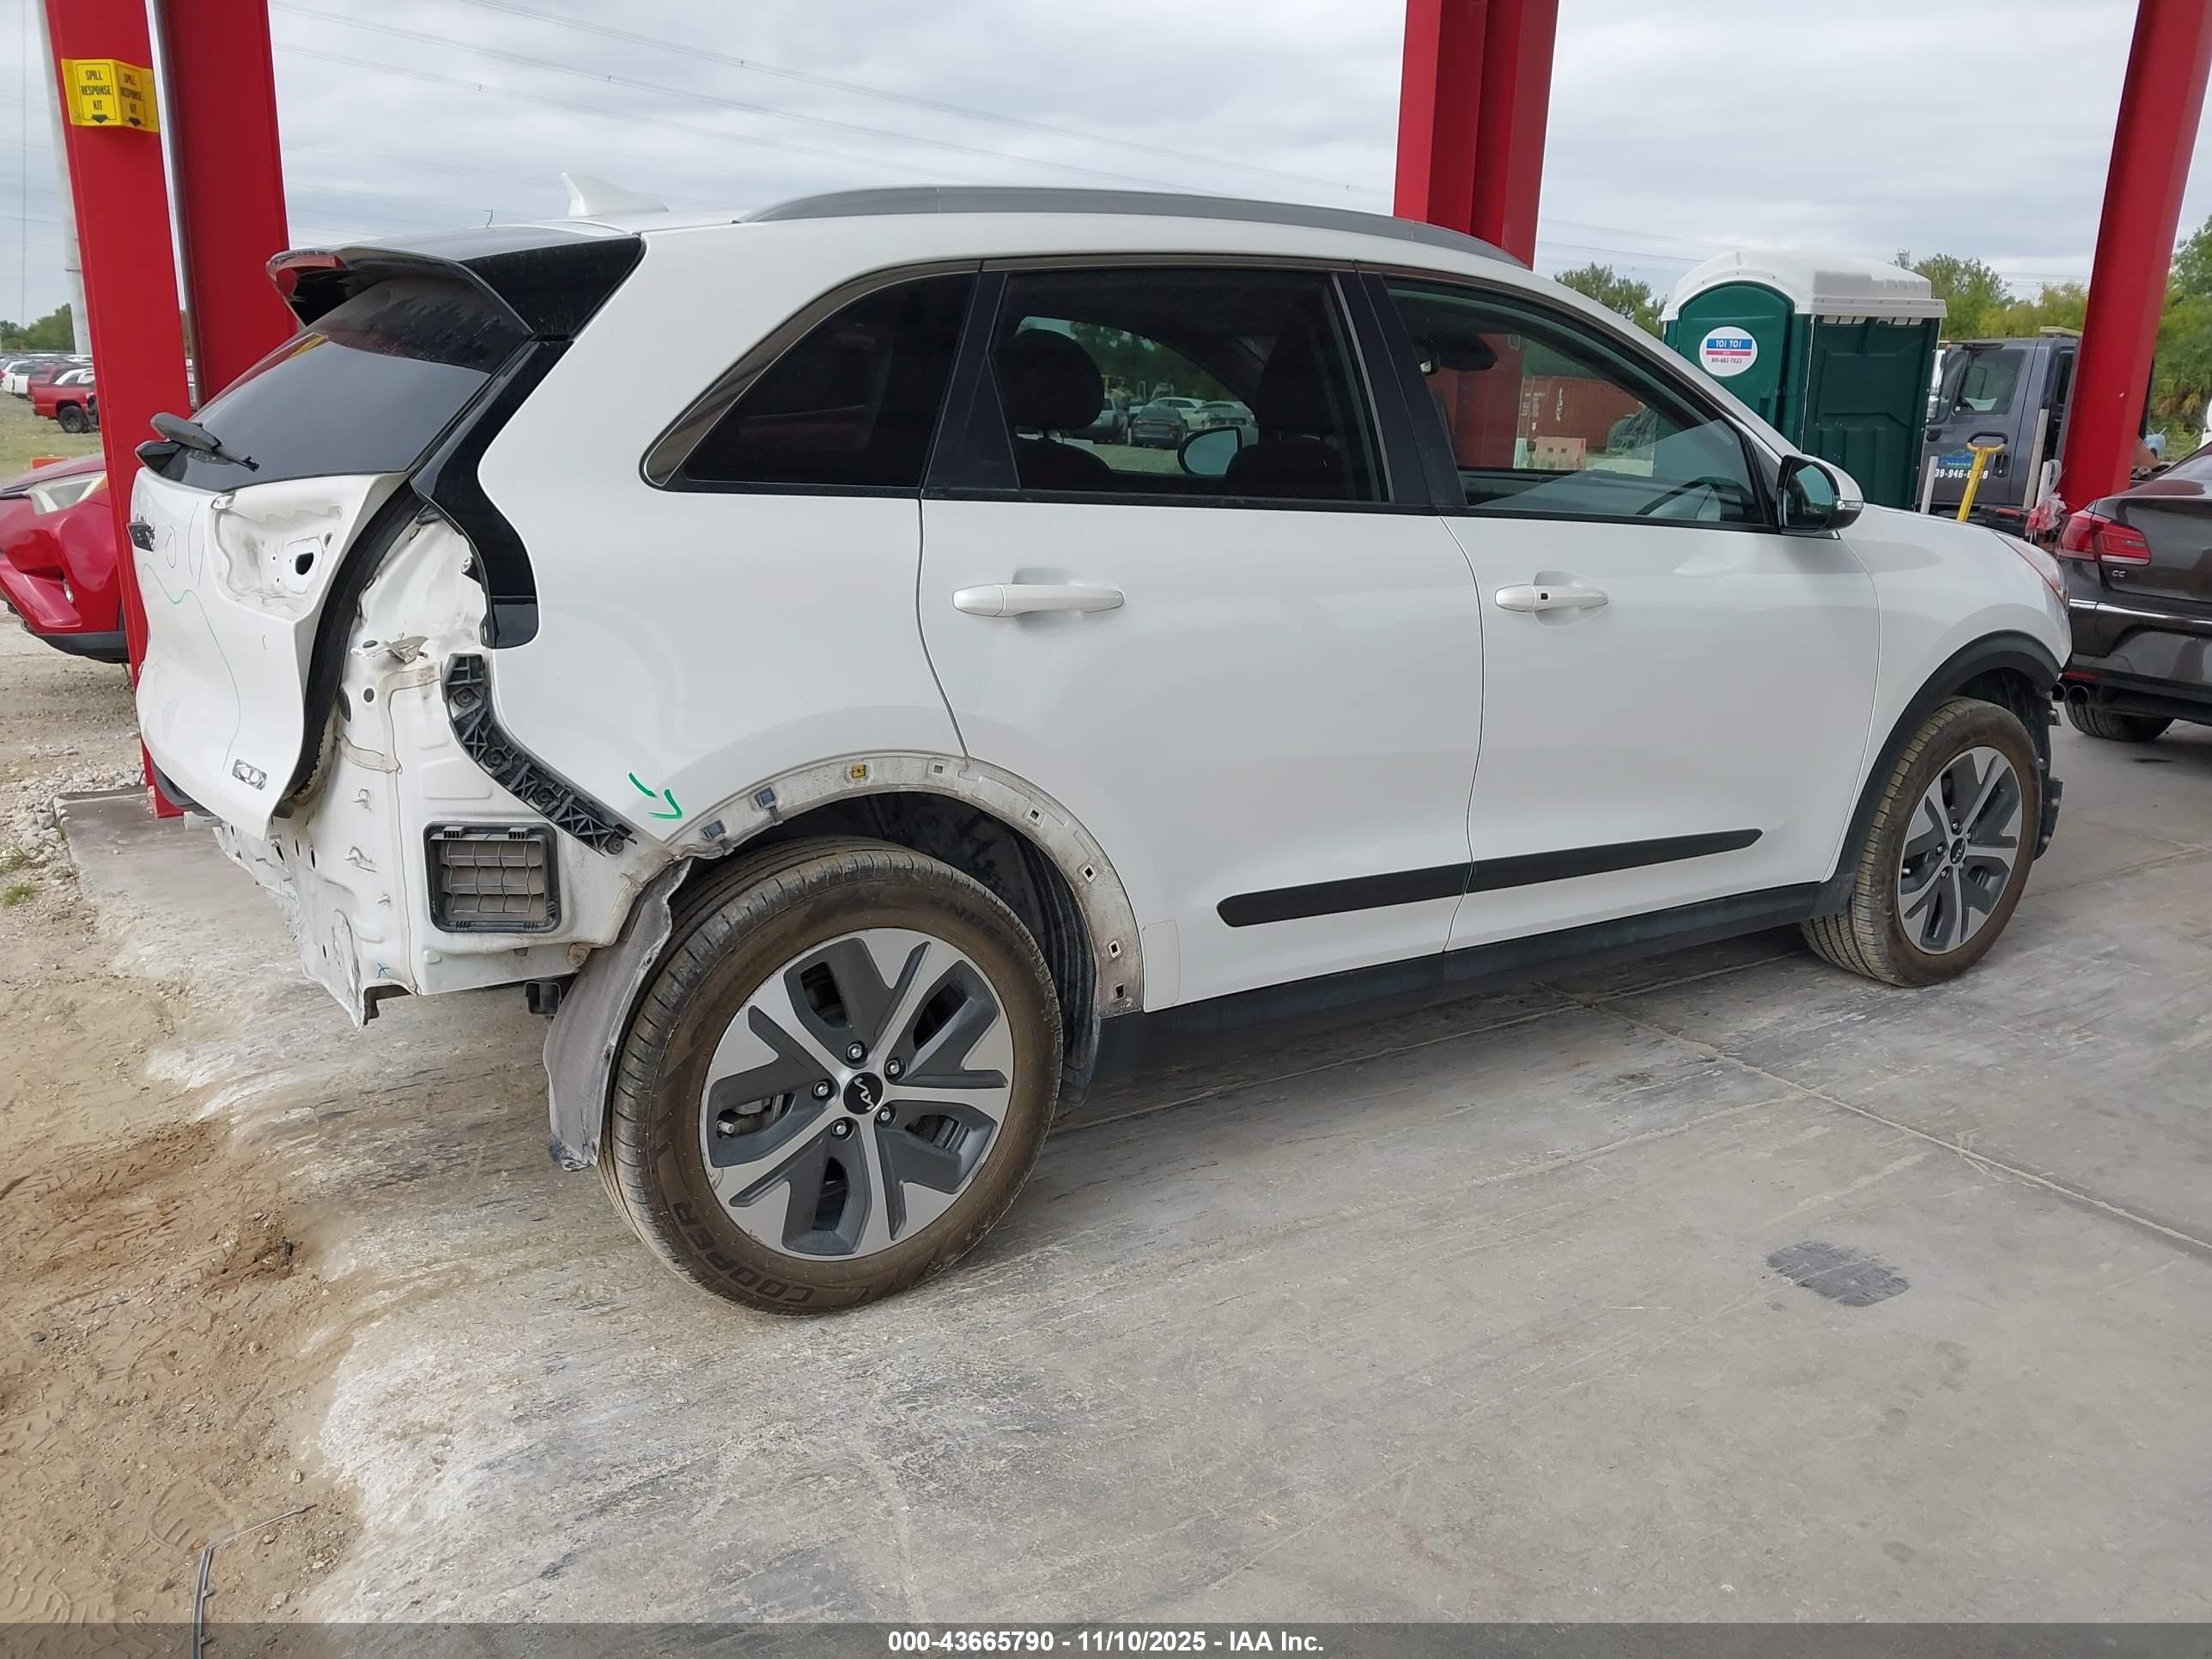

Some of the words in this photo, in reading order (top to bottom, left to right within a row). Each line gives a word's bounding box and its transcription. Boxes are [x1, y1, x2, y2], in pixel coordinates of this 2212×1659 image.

[86, 70, 103, 81] SPILL
[81, 85, 112, 96] RESPONSE
[93, 100, 103, 111] KIT
[1716, 339, 1727, 348] TOI
[1729, 339, 1742, 348] TOI
[2112, 569, 2126, 578] CC
[672, 1202, 815, 1303] COOPER
